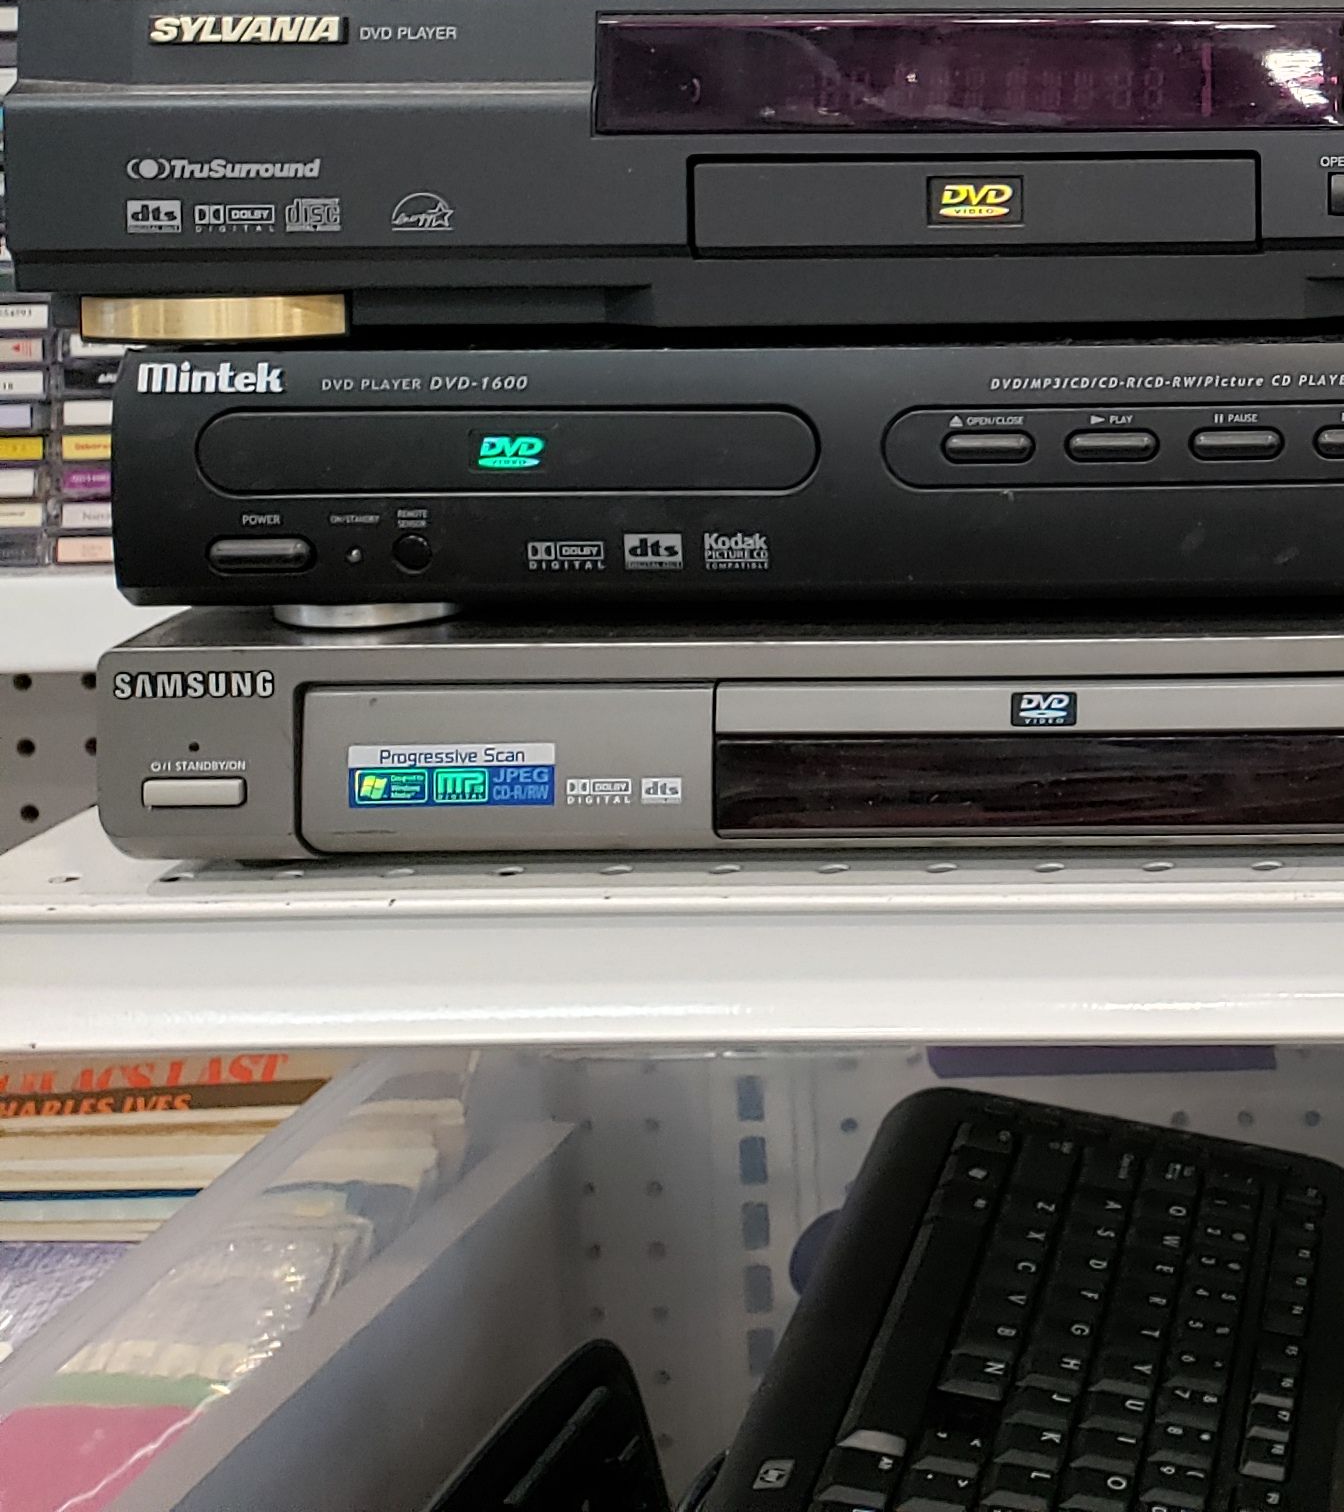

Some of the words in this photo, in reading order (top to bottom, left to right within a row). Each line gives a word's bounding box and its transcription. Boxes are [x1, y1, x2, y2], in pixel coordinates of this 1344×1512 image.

[150, 16, 340, 44] SYLVANIA
[359, 26, 392, 40] DVD
[397, 26, 456, 40] PLAYER
[170, 158, 321, 178] TruSurround
[941, 184, 1013, 204] DVD
[137, 361, 283, 393] Mintek
[322, 379, 353, 390] DVD
[361, 378, 421, 390] PLAYER
[430, 376, 528, 391] DVD-1600
[966, 416, 1024, 426] OPEN/CLOSE
[1109, 414, 1133, 424] PLAY
[1227, 413, 1258, 424] PAUSE
[242, 514, 281, 526] POWER
[704, 533, 768, 550] Kodak
[114, 670, 274, 699] SAMSUNG
[380, 749, 477, 769] Progressive
[484, 747, 525, 763] Scan
[176, 760, 246, 772] STANDBY/ON
[493, 768, 549, 783] JPEG
[493, 785, 549, 800] CD-R/RW
[567, 796, 631, 805] DIGITAL
